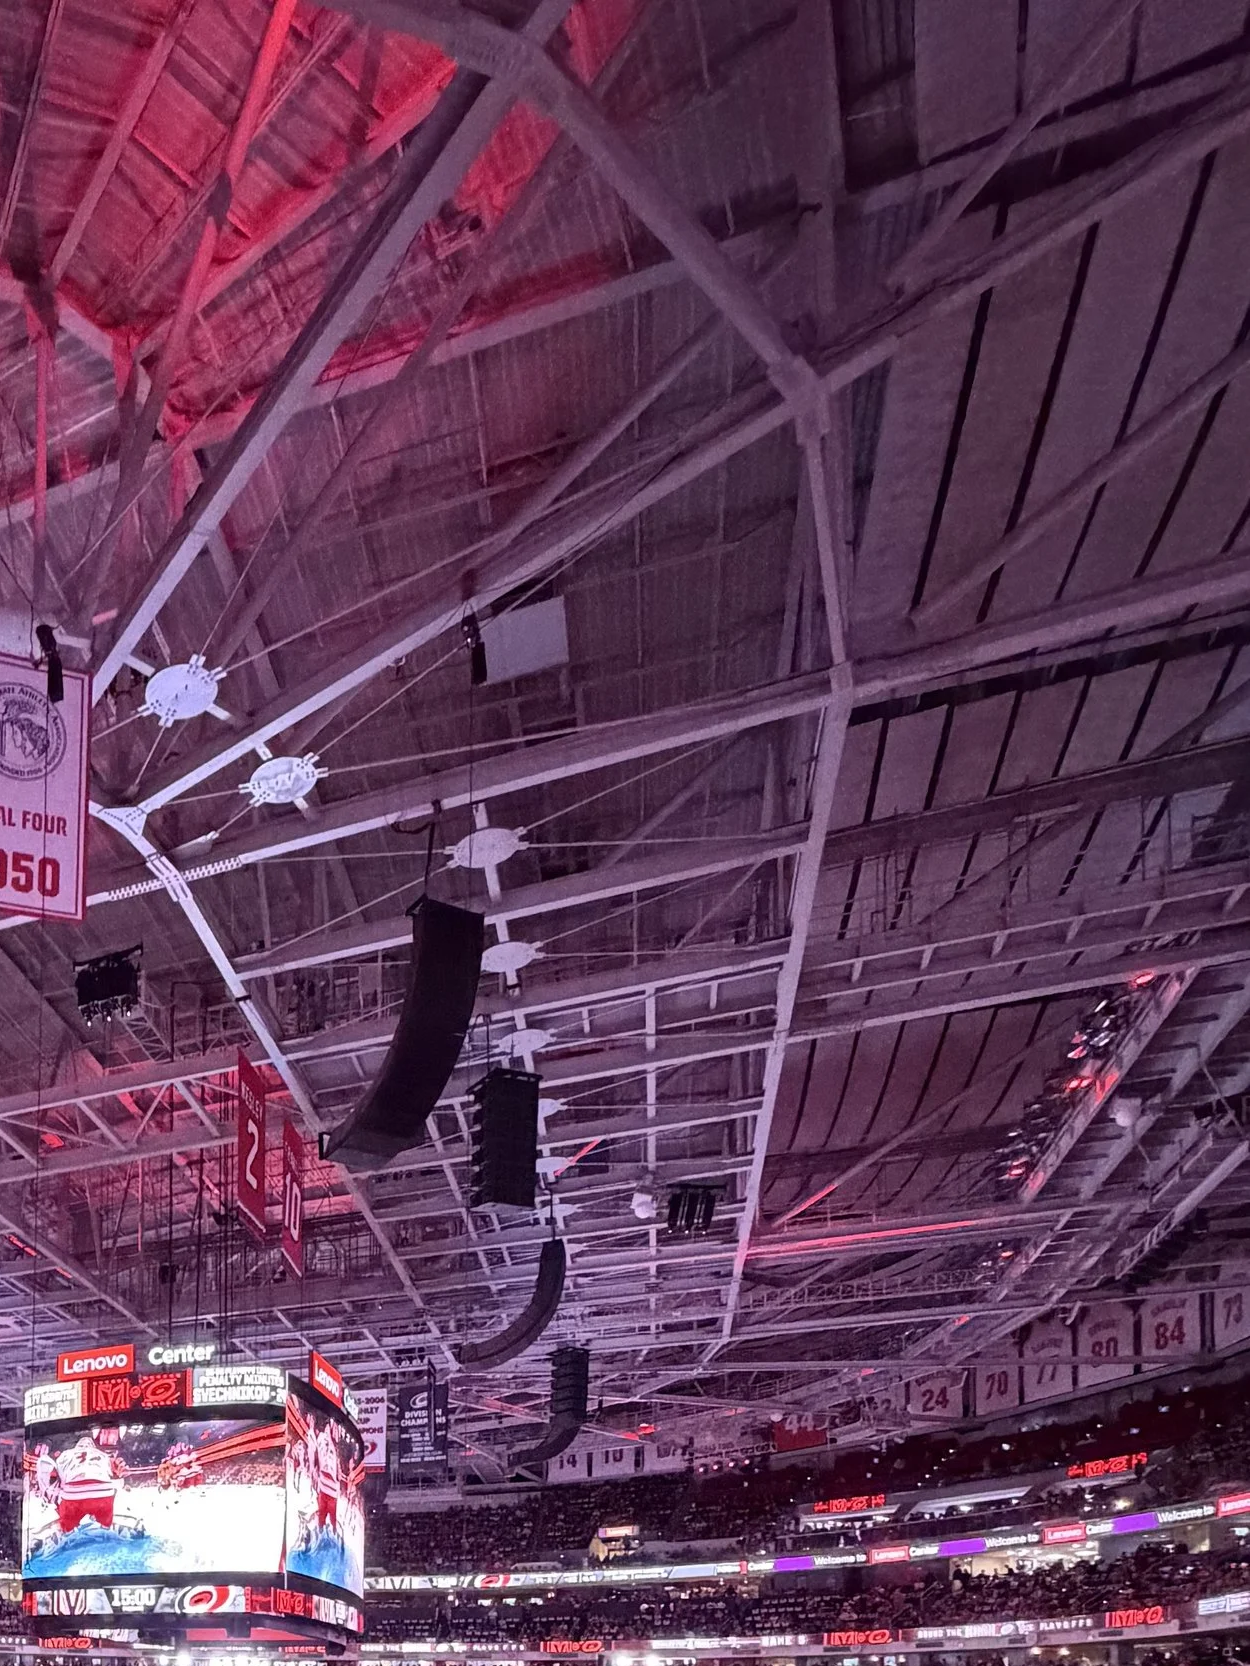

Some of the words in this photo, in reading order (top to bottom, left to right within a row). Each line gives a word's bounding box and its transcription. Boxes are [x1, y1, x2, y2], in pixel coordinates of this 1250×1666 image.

[22, 809, 67, 837] FOUR
[245, 1118, 259, 1190] 2
[284, 1172, 301, 1242] 10
[1154, 1316, 1185, 1350] 84
[63, 1353, 128, 1374] Lenovo
[148, 1344, 216, 1366] Center
[314, 1360, 340, 1398] Lenovo
[985, 1371, 1008, 1400] 70
[921, 1387, 949, 1412] 24
[400, 1416, 447, 1427] CHAMPNS
[405, 1408, 442, 1418] DIVISIN
[1156, 1506, 1202, 1523] Welcome
[985, 1534, 1026, 1548] Welcome
[814, 1554, 855, 1566] Welcome
[111, 1587, 156, 1606] 15:00
